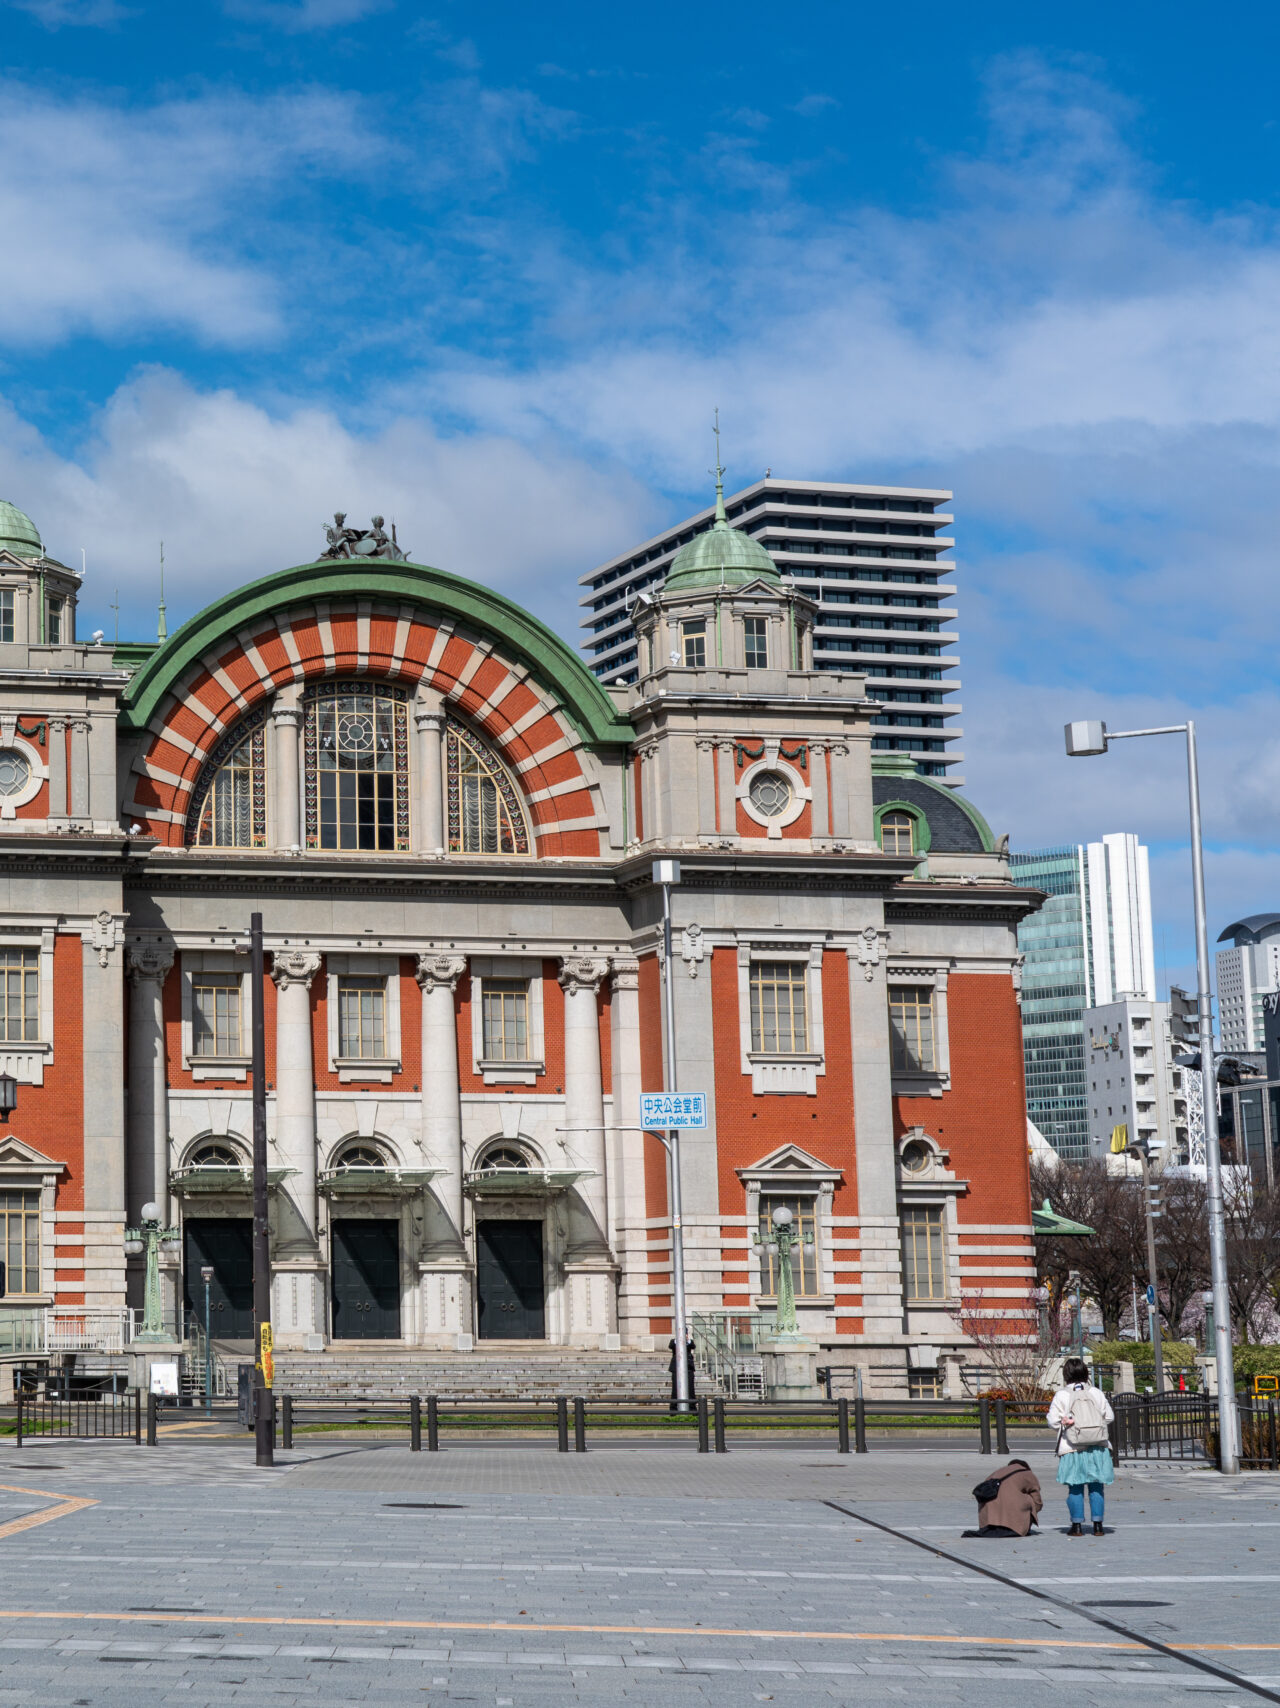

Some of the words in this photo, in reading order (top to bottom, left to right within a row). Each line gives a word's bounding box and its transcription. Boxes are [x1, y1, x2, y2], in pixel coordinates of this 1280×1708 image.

[644, 1097, 702, 1114] 中央公会堂前
[644, 1116, 666, 1125] Central
[669, 1116, 688, 1125] Public
[690, 1115, 702, 1125] Hall
